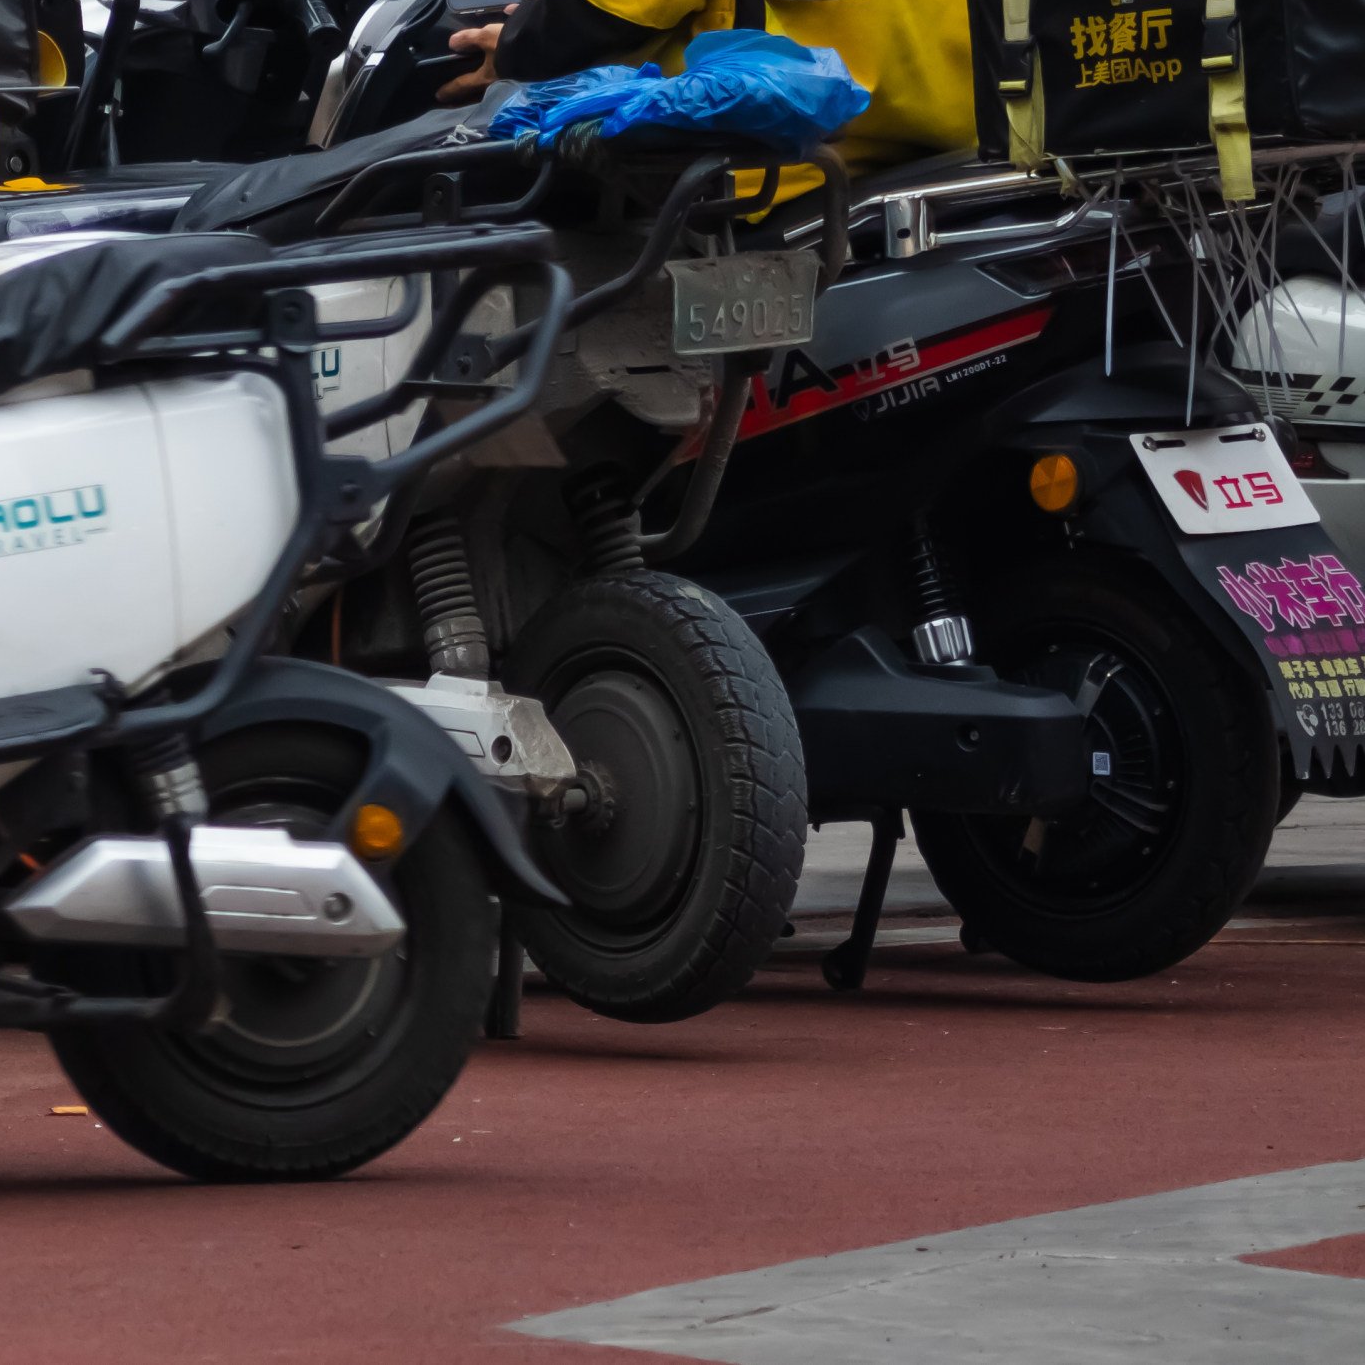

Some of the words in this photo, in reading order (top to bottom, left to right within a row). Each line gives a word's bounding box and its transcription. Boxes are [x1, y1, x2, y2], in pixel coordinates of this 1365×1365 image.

[1070, 7, 1174, 61] 找餐厅
[1074, 57, 1183, 90] 上美团App
[876, 376, 942, 414] JIJIA
[1212, 471, 1284, 510] 立马
[1216, 554, 1365, 632] 小米车行
[1321, 702, 1344, 721] 133
[1325, 719, 1347, 737] 136
